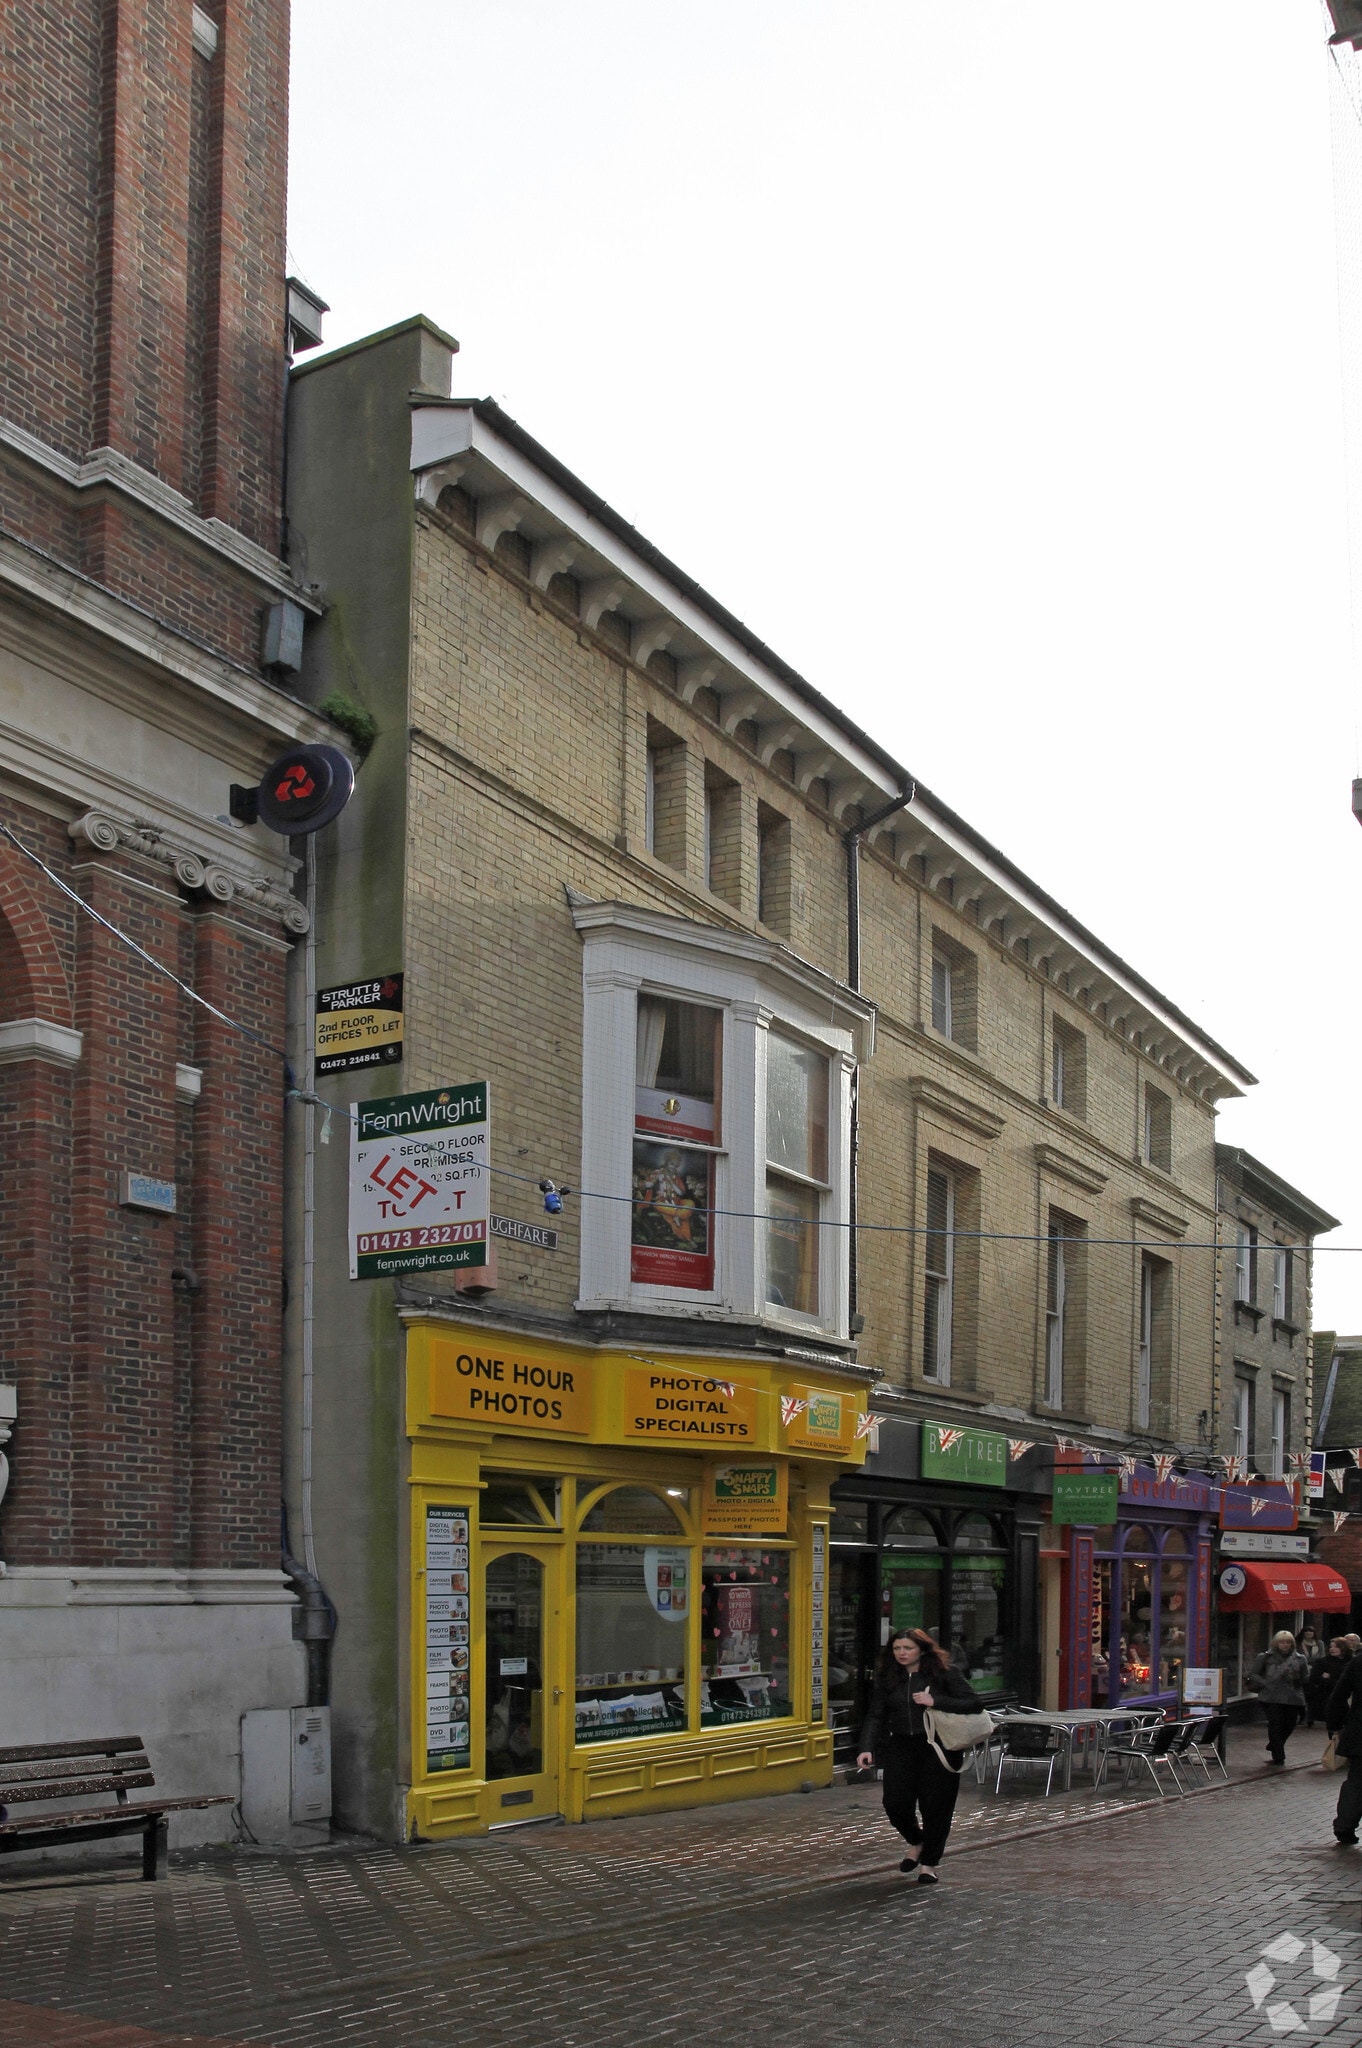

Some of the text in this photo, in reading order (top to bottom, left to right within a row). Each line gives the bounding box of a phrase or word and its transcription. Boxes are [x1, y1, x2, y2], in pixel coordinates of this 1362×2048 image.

[321, 982, 381, 1003] STRUTT &
[330, 992, 381, 1010] PARKER
[318, 1014, 375, 1033] 2nd FLOOR
[318, 1019, 401, 1044] OFFICES TO LET
[320, 1052, 381, 1069] 01473 214841
[362, 1095, 482, 1133] FennWright
[399, 1134, 485, 1156] SECOD FLOOR
[414, 1150, 475, 1169] PRMISES
[369, 1153, 439, 1210] LET
[359, 1222, 483, 1252] 01473 232701
[376, 1250, 470, 1270] fennwright.co.uk
[456, 1354, 575, 1392] ONE HOUR
[650, 1376, 718, 1393] PHOTO
[470, 1388, 562, 1420] PHOTOS
[655, 1397, 728, 1414] DIGITAL
[634, 1417, 748, 1436] SPECIALISTS
[723, 1470, 773, 1487] SNAPPY
[729, 1483, 771, 1496] SNAPS
[1057, 1486, 1113, 1494] BAYTREE
[728, 1619, 752, 1630] ONE!
